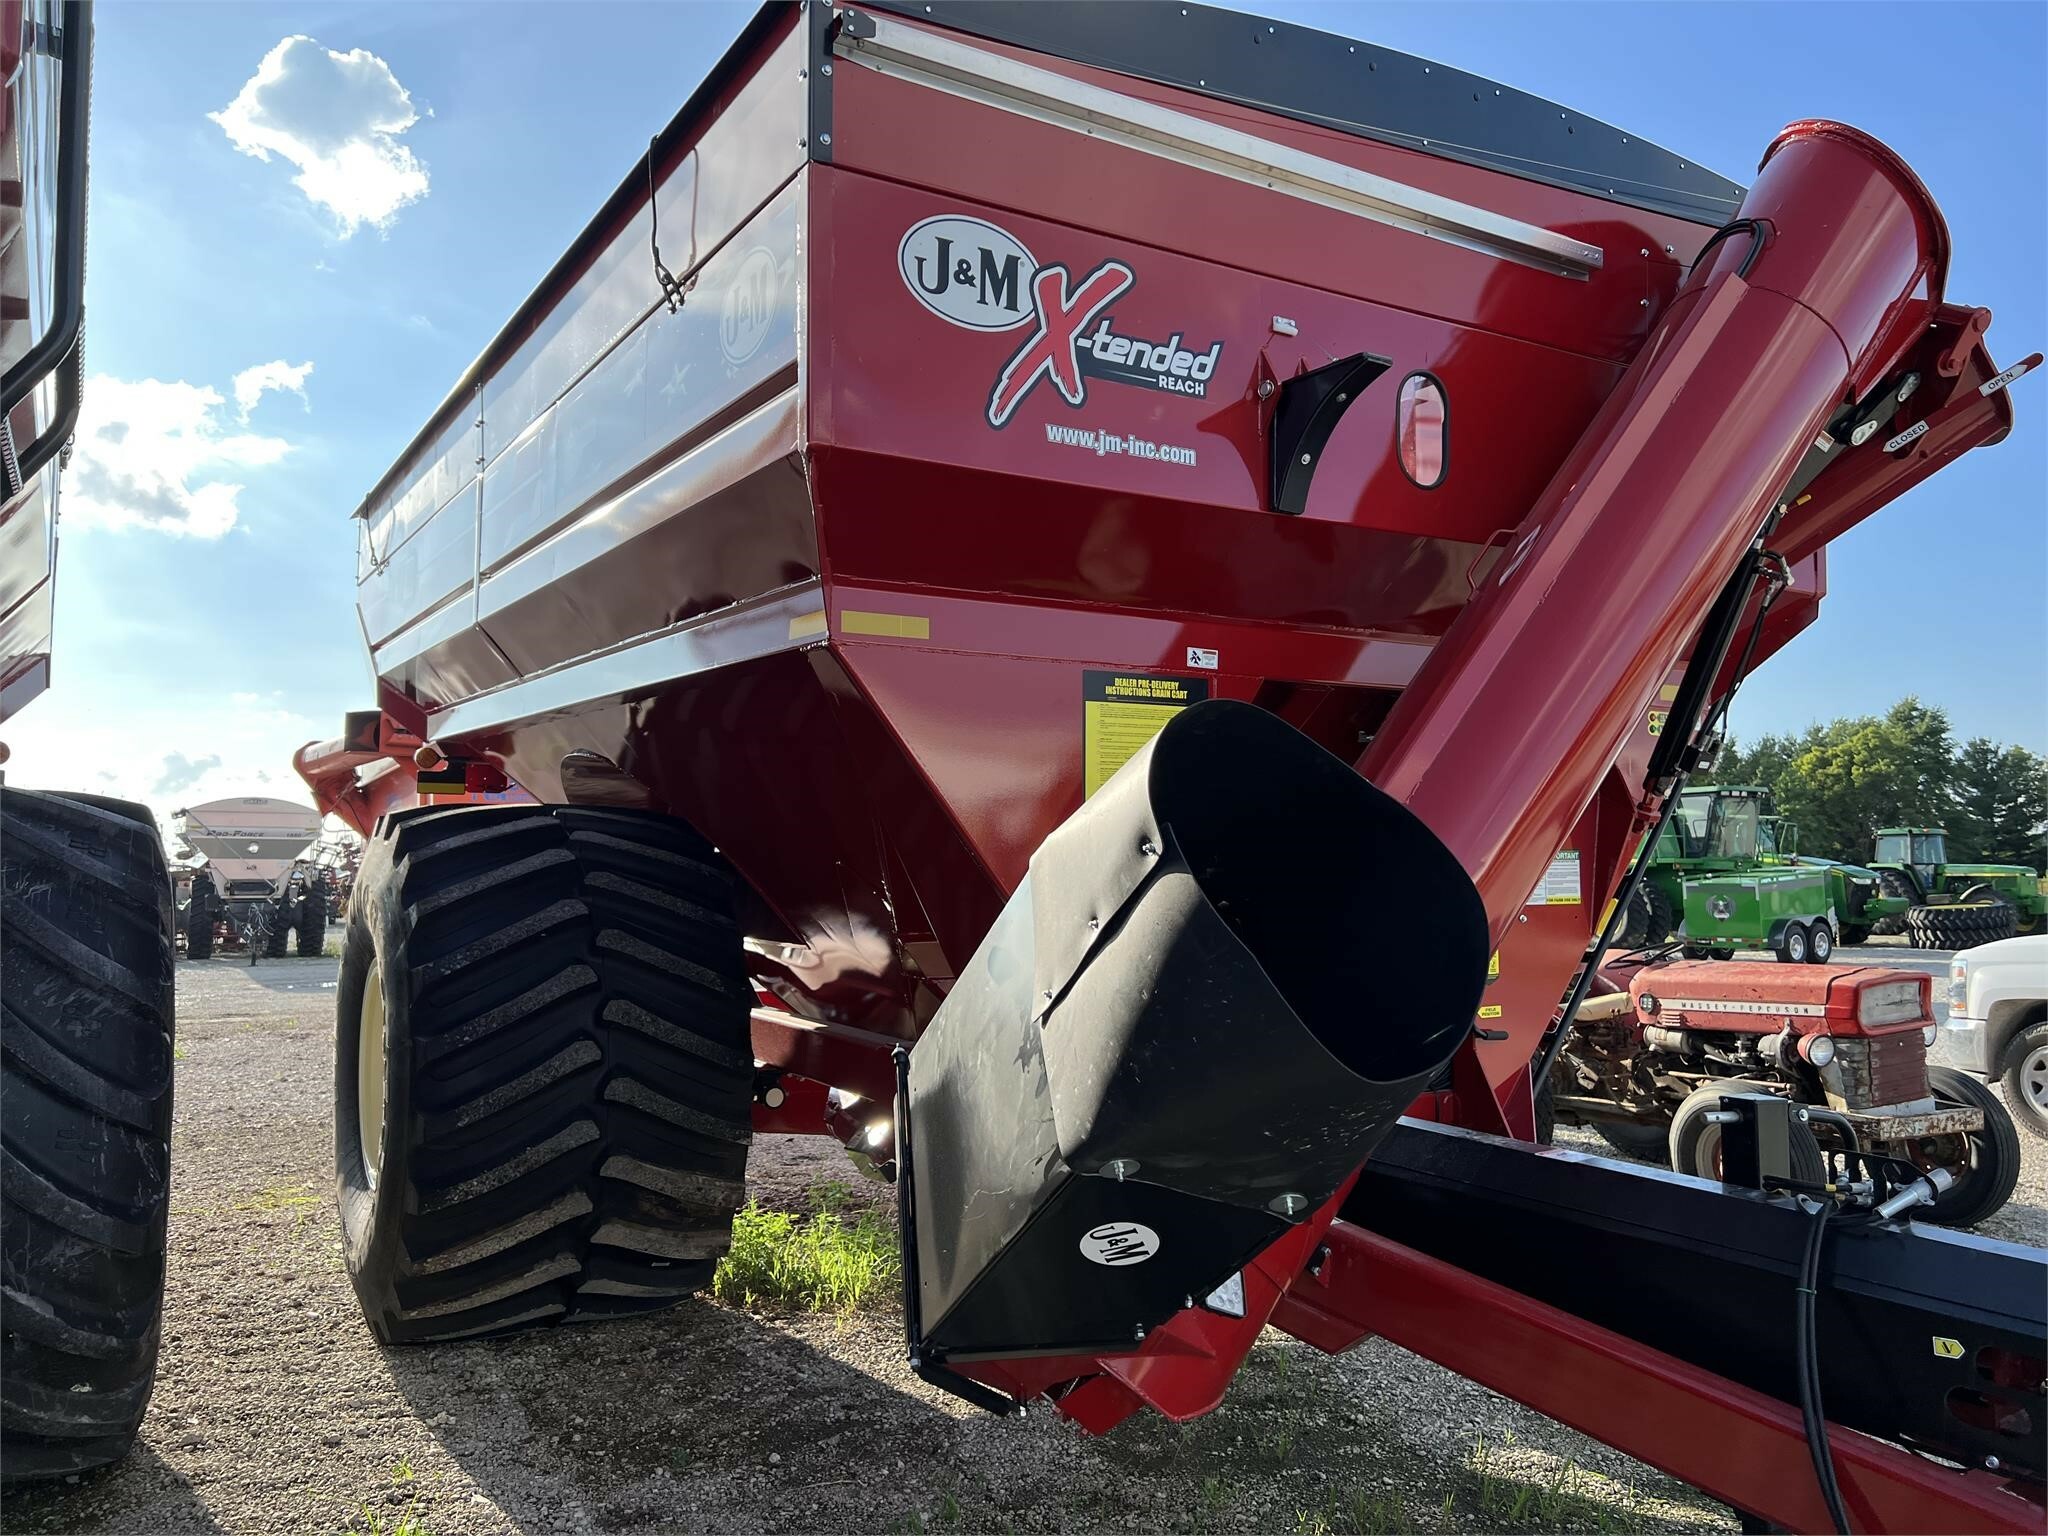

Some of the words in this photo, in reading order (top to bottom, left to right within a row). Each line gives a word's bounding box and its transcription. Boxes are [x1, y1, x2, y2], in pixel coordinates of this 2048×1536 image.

[914, 236, 1021, 313] J&M
[1158, 374, 1205, 397] REACH
[1987, 371, 2014, 390] OPEN
[1045, 423, 1197, 467] www.jm-inc.com
[1889, 424, 1926, 450] CLOSED
[1105, 685, 1151, 698] INSTRUCTIONS
[1151, 688, 1171, 698] GRAIN
[1171, 690, 1188, 700] CART
[1114, 677, 1137, 688] DEALER
[1137, 679, 1180, 691] PRE-DELIVERY
[1089, 1225, 1150, 1264] J&M
